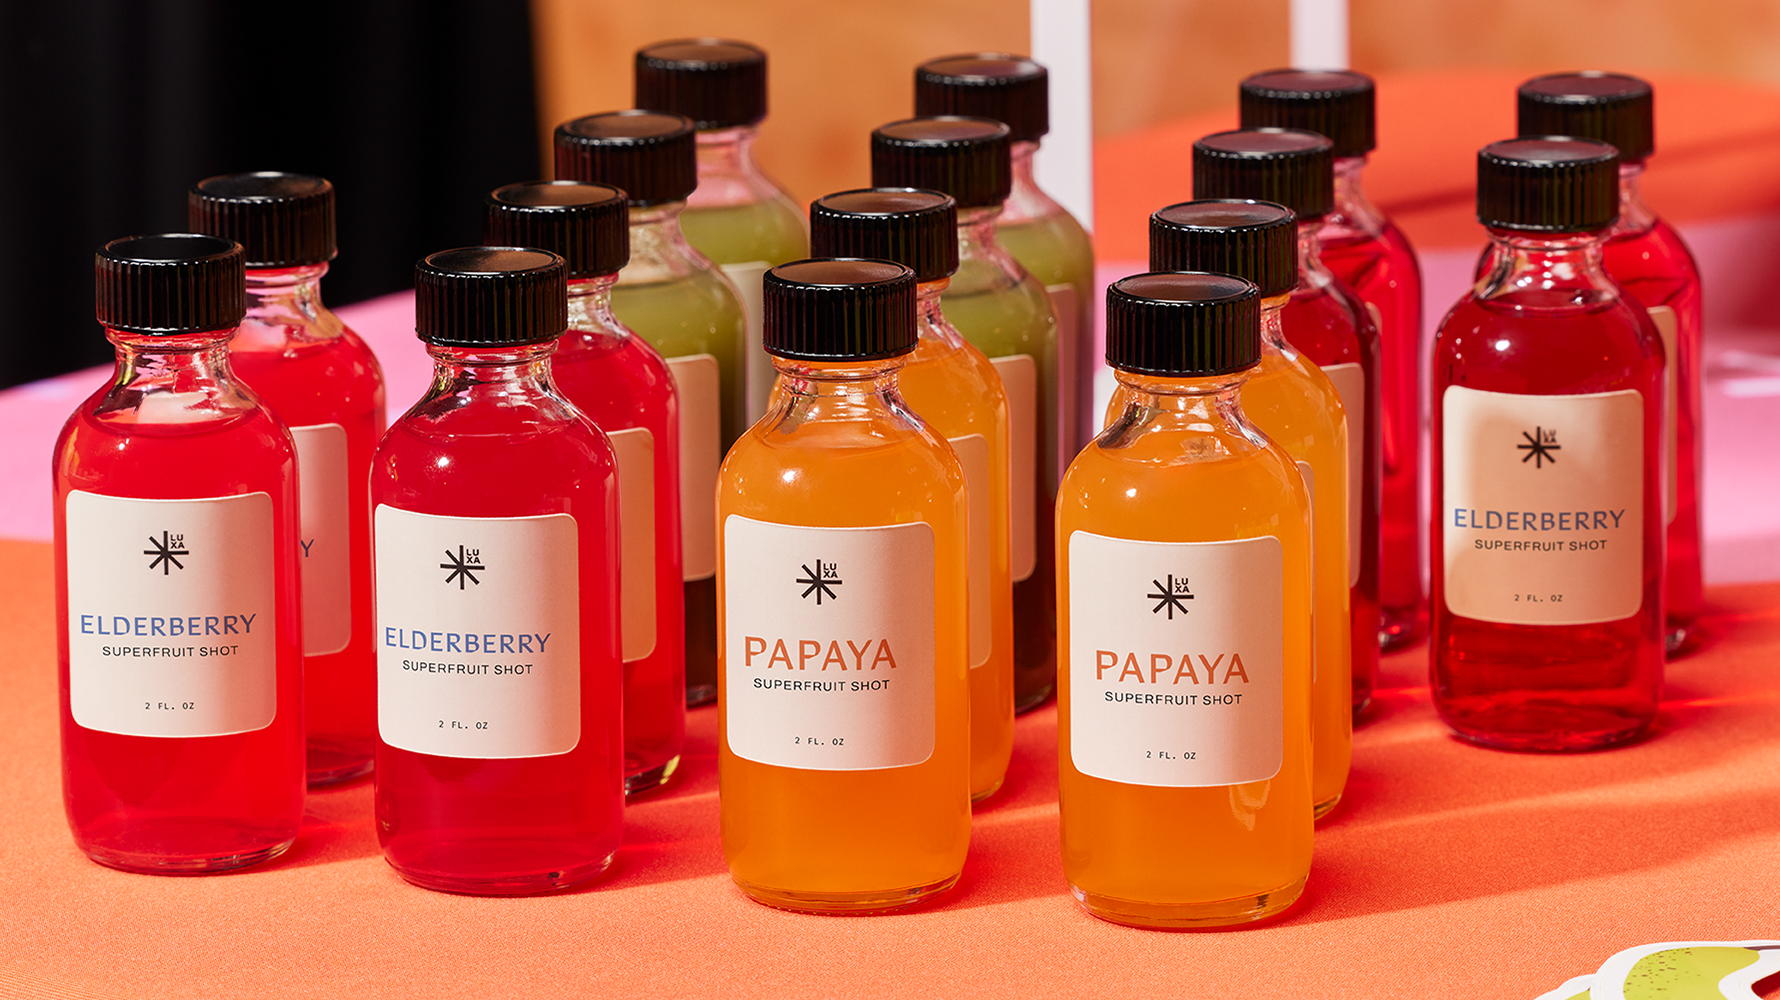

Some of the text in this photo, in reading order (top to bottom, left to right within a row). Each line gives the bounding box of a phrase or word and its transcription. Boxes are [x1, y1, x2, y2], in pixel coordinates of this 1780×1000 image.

[1455, 509, 1624, 531] ELDERBERRY
[1475, 539, 1607, 551] SUPERFRUIT SHOT
[1514, 594, 1520, 602] 2
[1527, 594, 1543, 602] FL.
[81, 614, 256, 636] ELDERBERRY
[386, 627, 550, 653] ELDERBERRY
[103, 646, 238, 657] SUPERFRUIT SHOT
[745, 636, 896, 671] PAPAYA
[403, 660, 532, 675] SUPERFRUIT SHOT
[1096, 650, 1249, 685] PAPAYA
[754, 678, 889, 691] SUPERFRUIT SHOT
[1105, 691, 1242, 705] SUPERFRUIT SHOT
[145, 702, 151, 710] 2
[158, 702, 174, 710] FL.
[438, 720, 445, 729] 2
[452, 720, 468, 729] FL.
[794, 737, 801, 745] 2
[808, 737, 824, 745] FL.
[1146, 751, 1152, 759] 2
[1159, 751, 1175, 759] FL.
